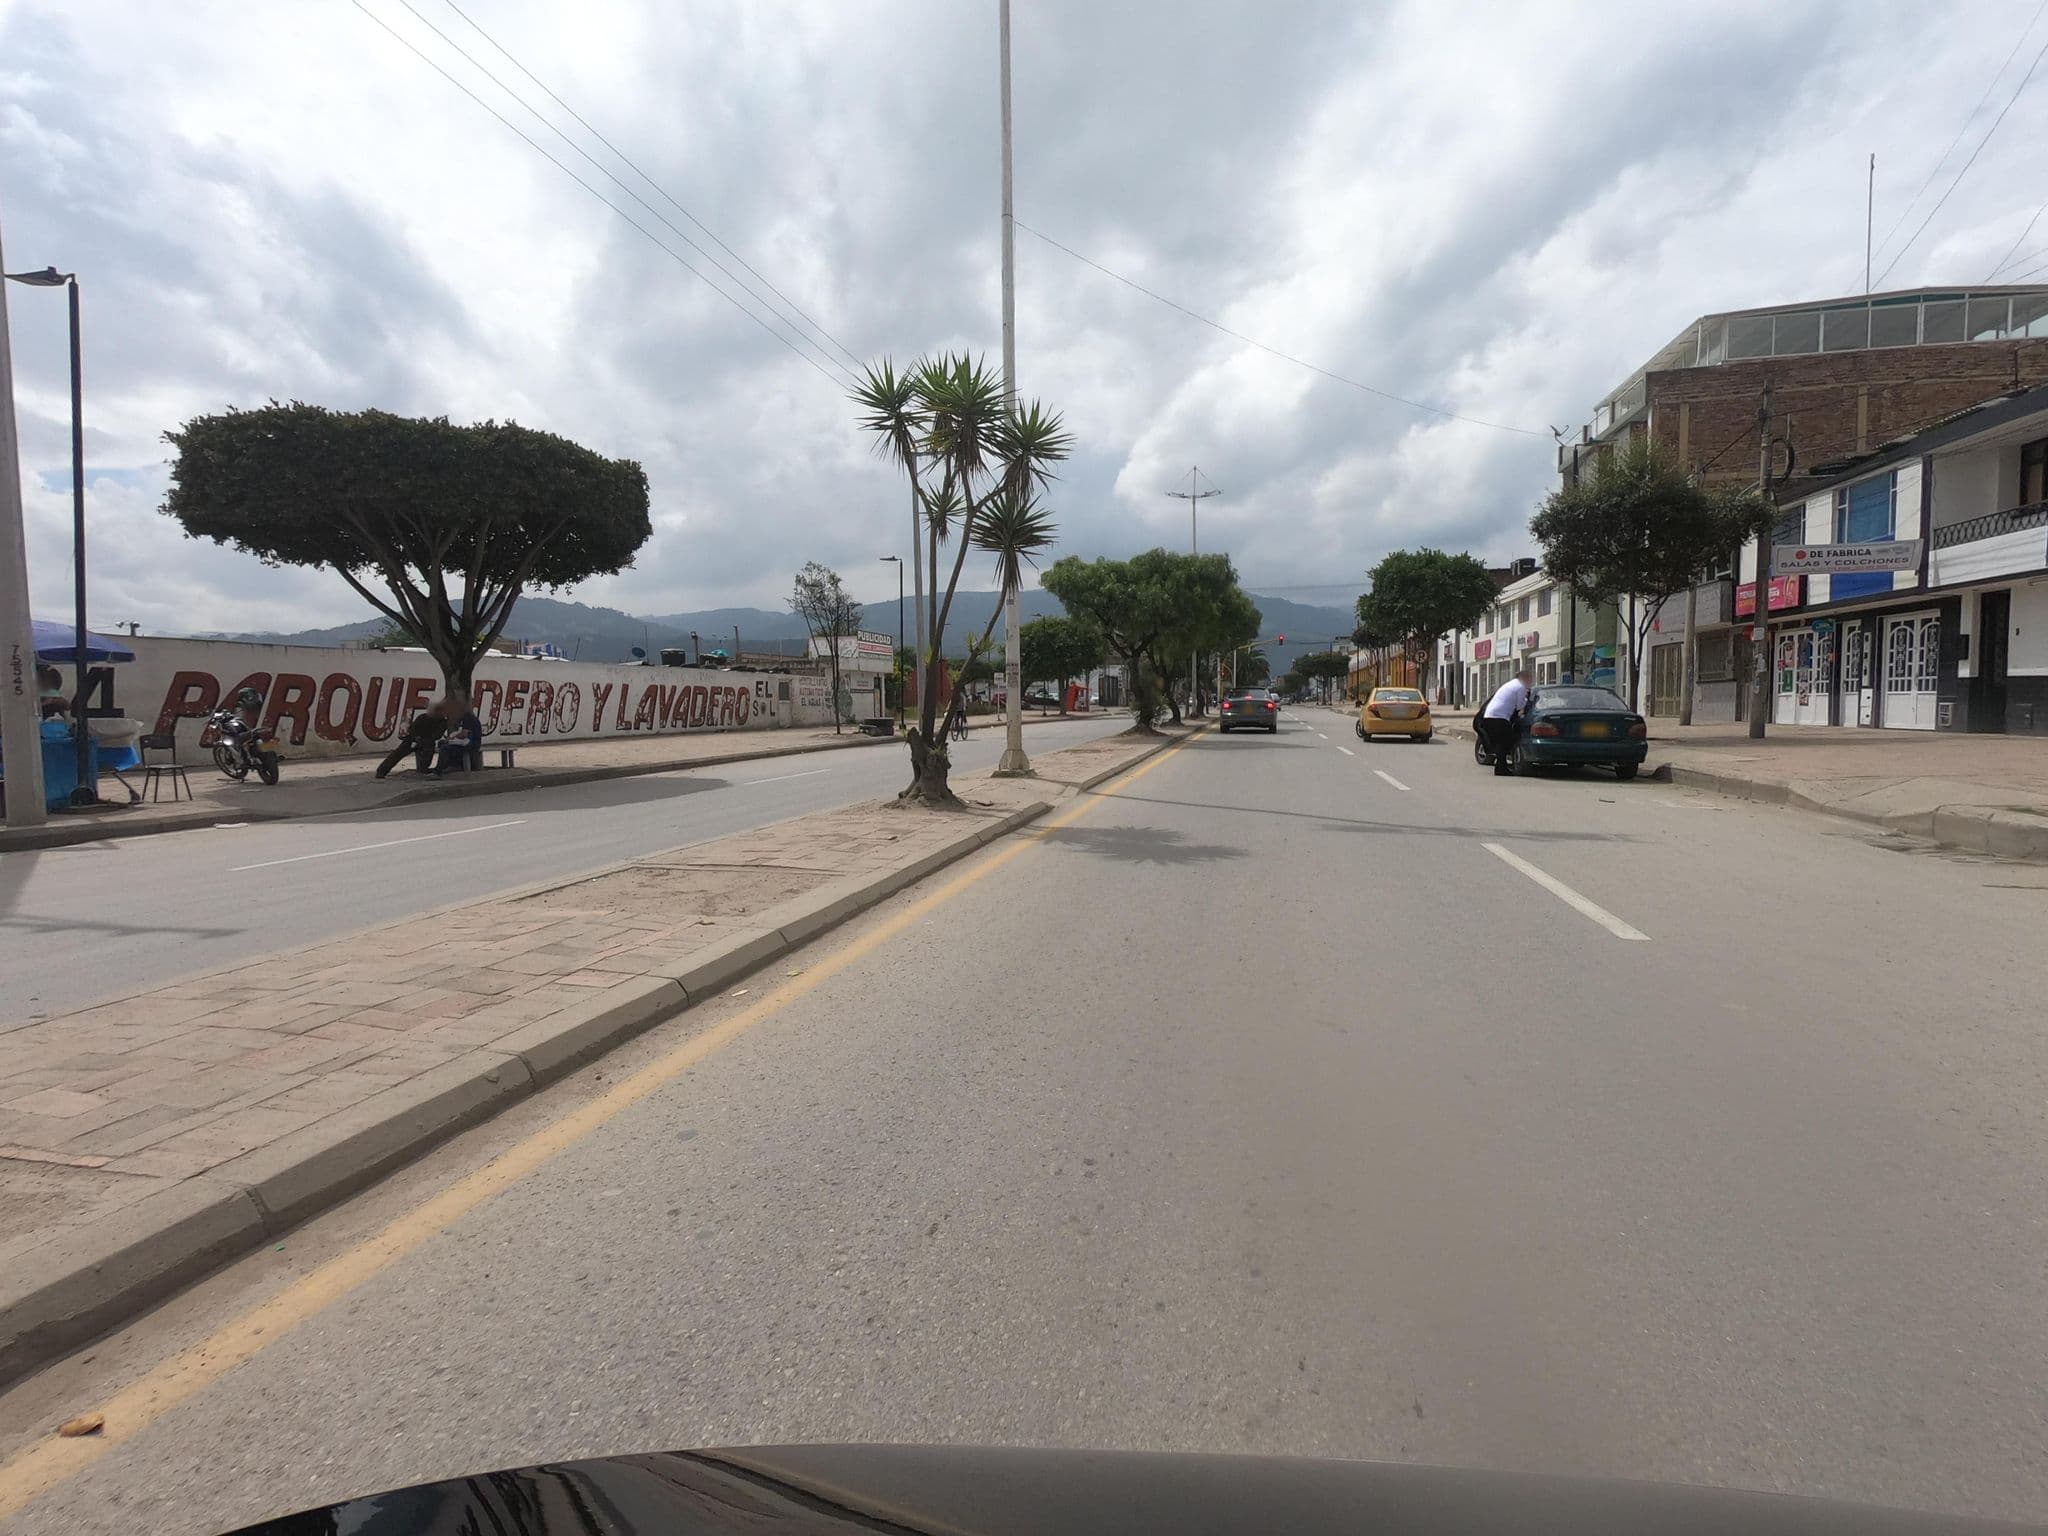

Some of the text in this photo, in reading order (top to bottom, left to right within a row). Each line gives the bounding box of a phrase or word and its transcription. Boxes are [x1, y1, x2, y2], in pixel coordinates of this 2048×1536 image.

[1810, 550, 1823, 558] DE
[1827, 548, 1872, 558] FABRICA
[1780, 560, 1820, 568] SALAS
[1834, 557, 1909, 566] COLCHONES
[857, 630, 891, 644] PUBLICIDAD
[755, 680, 773, 698] EL
[152, 671, 750, 747] PARQUEDERO Y LAVADERO
